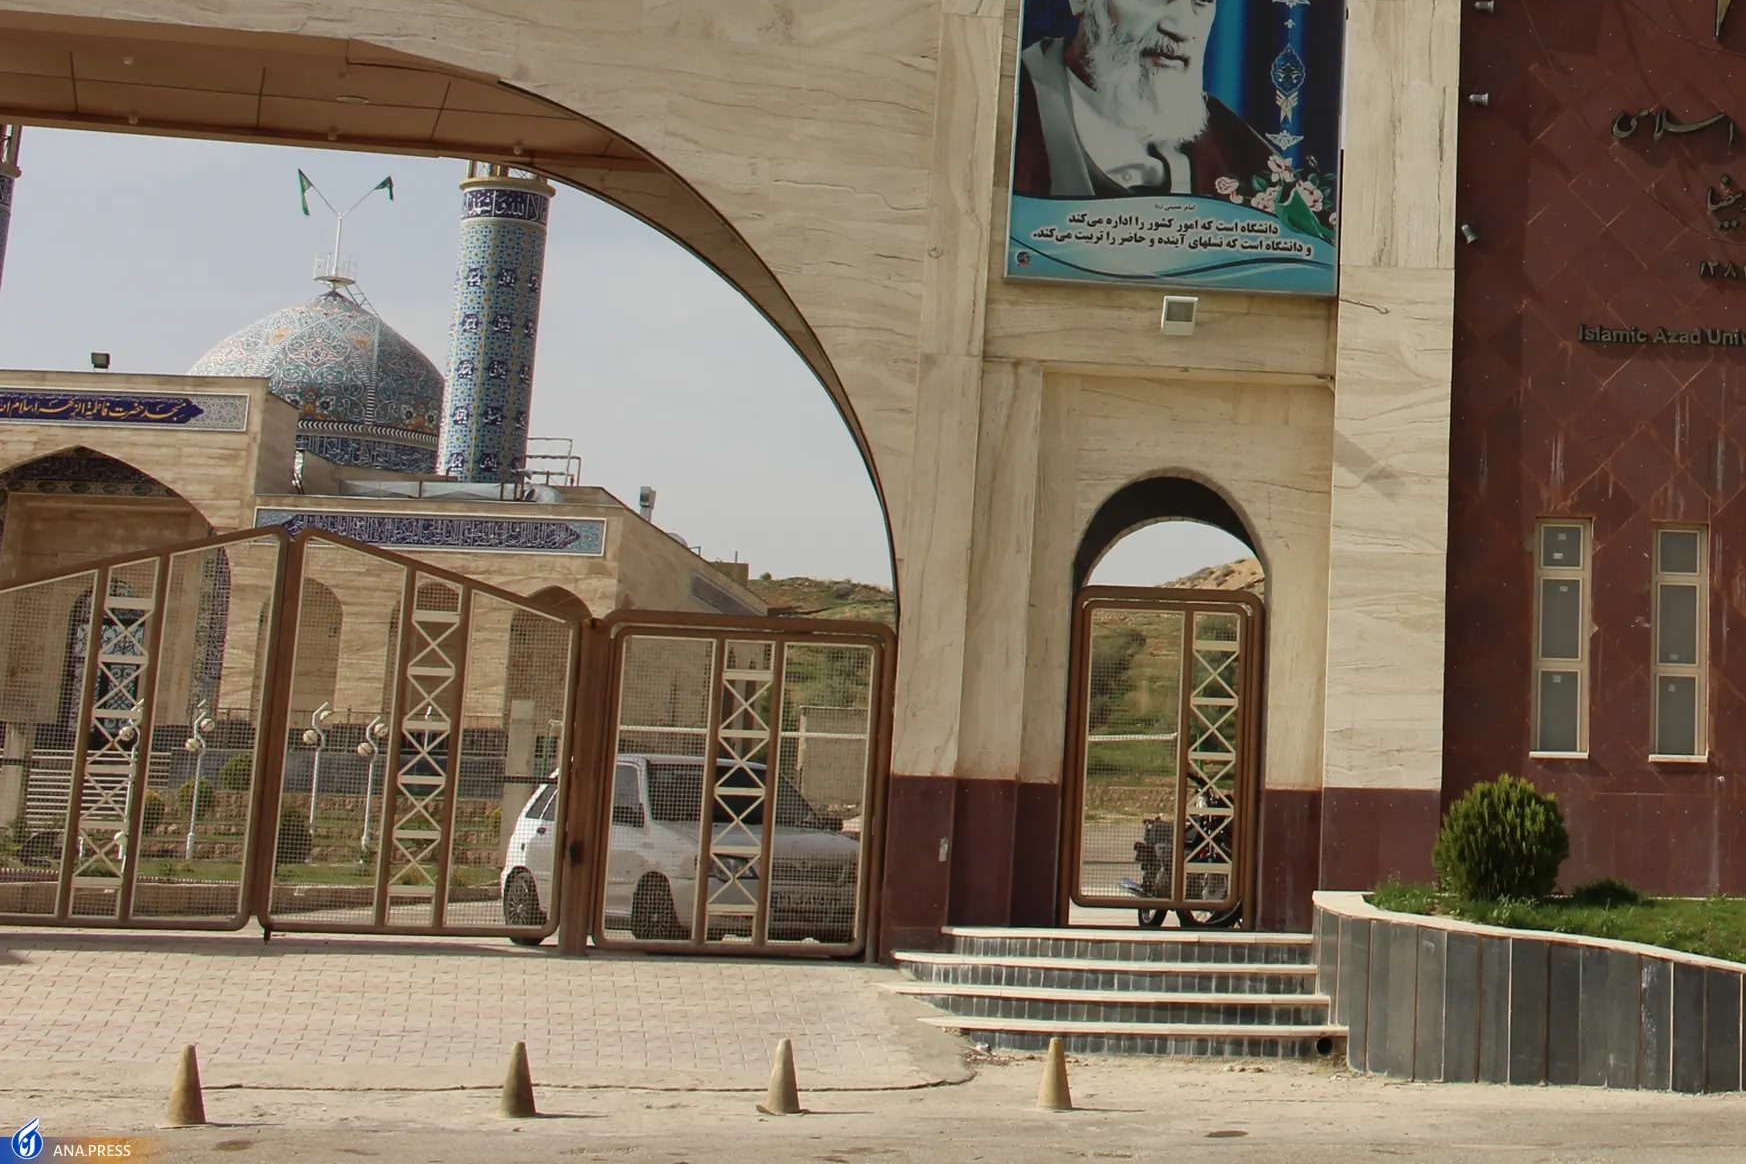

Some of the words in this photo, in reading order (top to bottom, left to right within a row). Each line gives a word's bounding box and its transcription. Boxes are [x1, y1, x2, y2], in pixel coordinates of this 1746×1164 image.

[1612, 106, 1735, 147] اسلامی
[1707, 175, 1745, 230] بیضا
[1106, 213, 1132, 229] اداره
[1135, 215, 1145, 230] را
[1147, 217, 1174, 231] کشور
[1177, 219, 1198, 233] امور
[1201, 220, 1213, 231] که
[1216, 222, 1238, 233] است
[1241, 223, 1278, 235] دانشگاه
[1075, 230, 1104, 244] تربیت
[1106, 230, 1116, 244] را
[1118, 232, 1146, 246] حاضر
[1149, 237, 1155, 247] و
[1157, 234, 1185, 248] آینده
[1188, 236, 1223, 250] نسلهای
[1226, 238, 1238, 249] که
[1241, 239, 1263, 250] است
[1266, 240, 1303, 253] دانشگاه
[1305, 246, 1312, 256] و
[1578, 324, 1648, 343] Islamic
[1652, 327, 1701, 345] Azad
[109, 402, 145, 419] حضرت
[140, 402, 187, 421] مسجد
